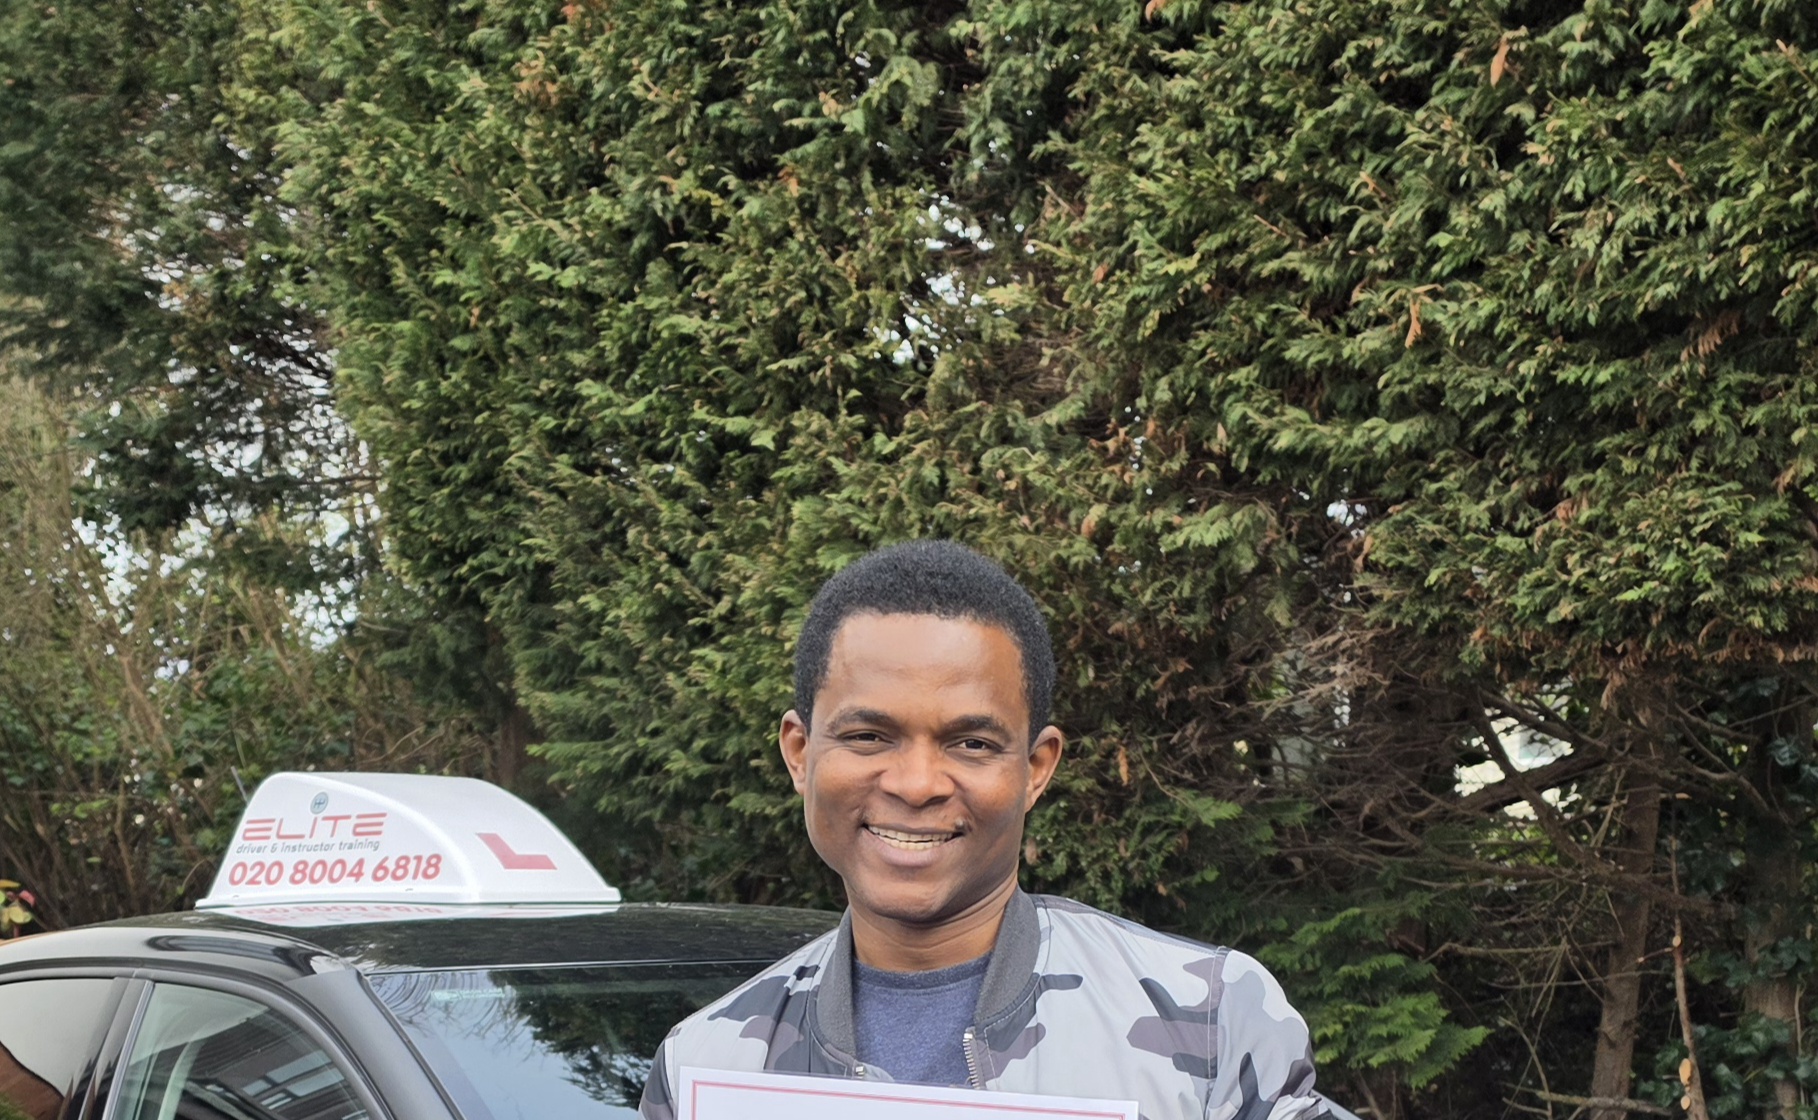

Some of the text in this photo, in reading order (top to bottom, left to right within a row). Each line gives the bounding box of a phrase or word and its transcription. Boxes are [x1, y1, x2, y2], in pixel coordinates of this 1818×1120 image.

[242, 812, 387, 841] ELITE
[236, 838, 380, 854] driver & instructor training
[228, 853, 442, 886] 020 8004 6818
